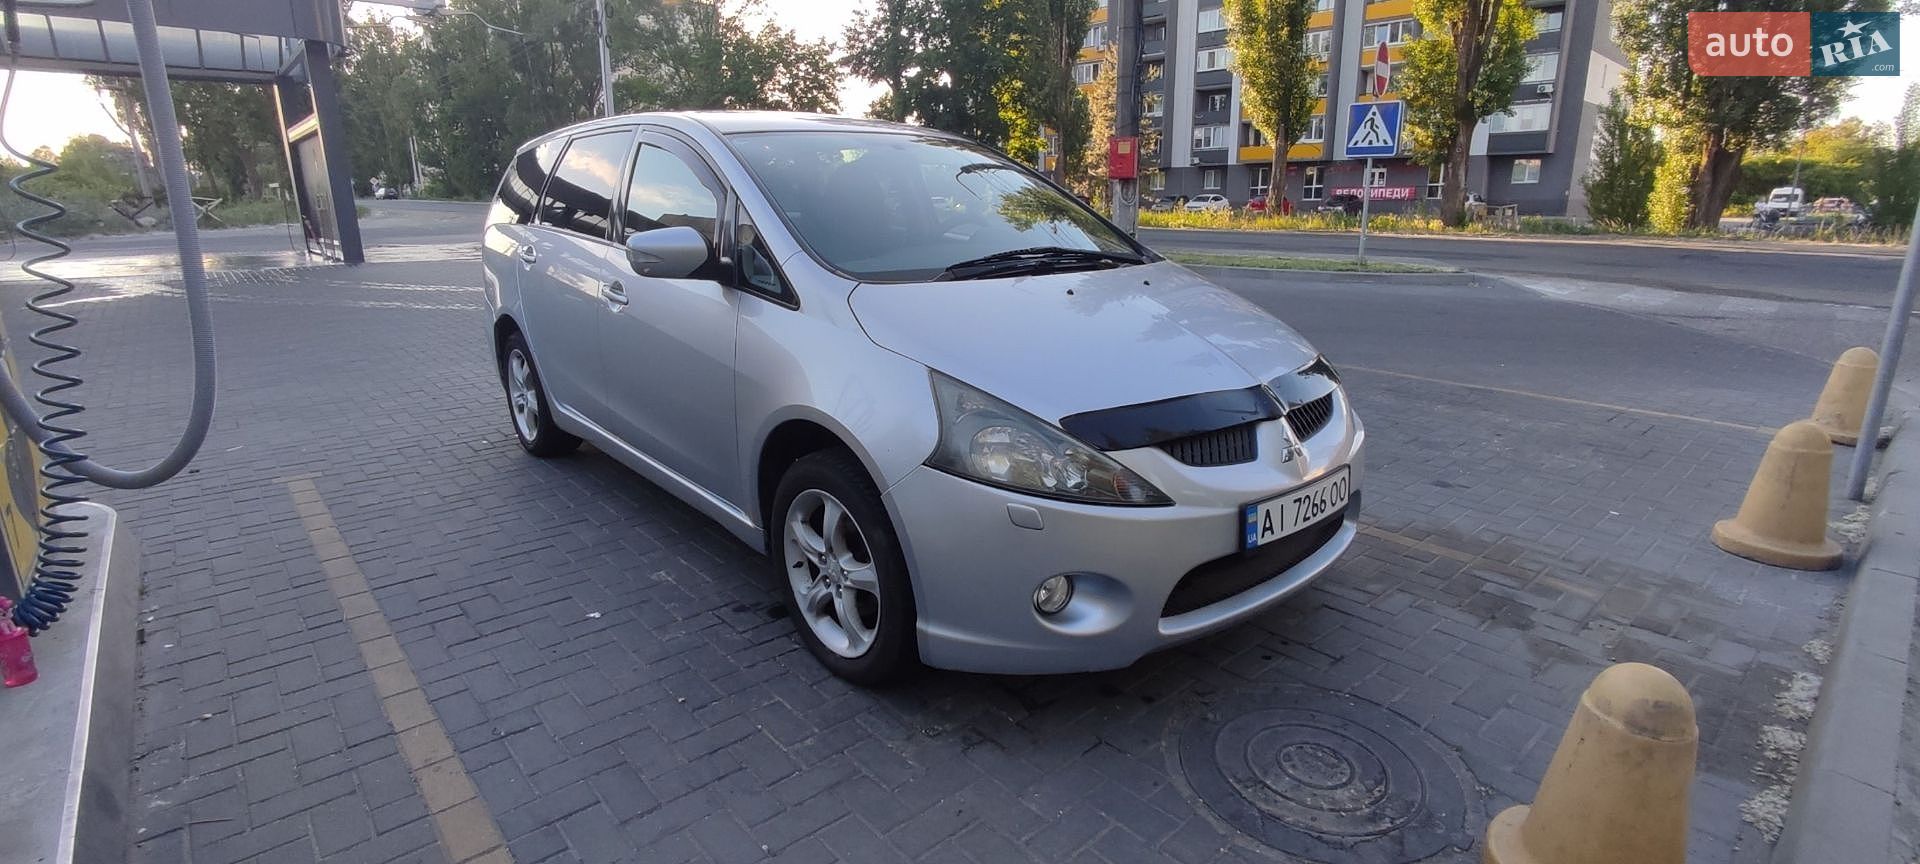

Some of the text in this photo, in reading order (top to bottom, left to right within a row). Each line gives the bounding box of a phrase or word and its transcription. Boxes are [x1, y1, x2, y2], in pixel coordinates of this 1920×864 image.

[1336, 188, 1409, 200] ВЕЛОИПЕДИ
[1261, 504, 1284, 539] AI
[1293, 487, 1327, 534] 7266
[1248, 534, 1257, 543] UA
